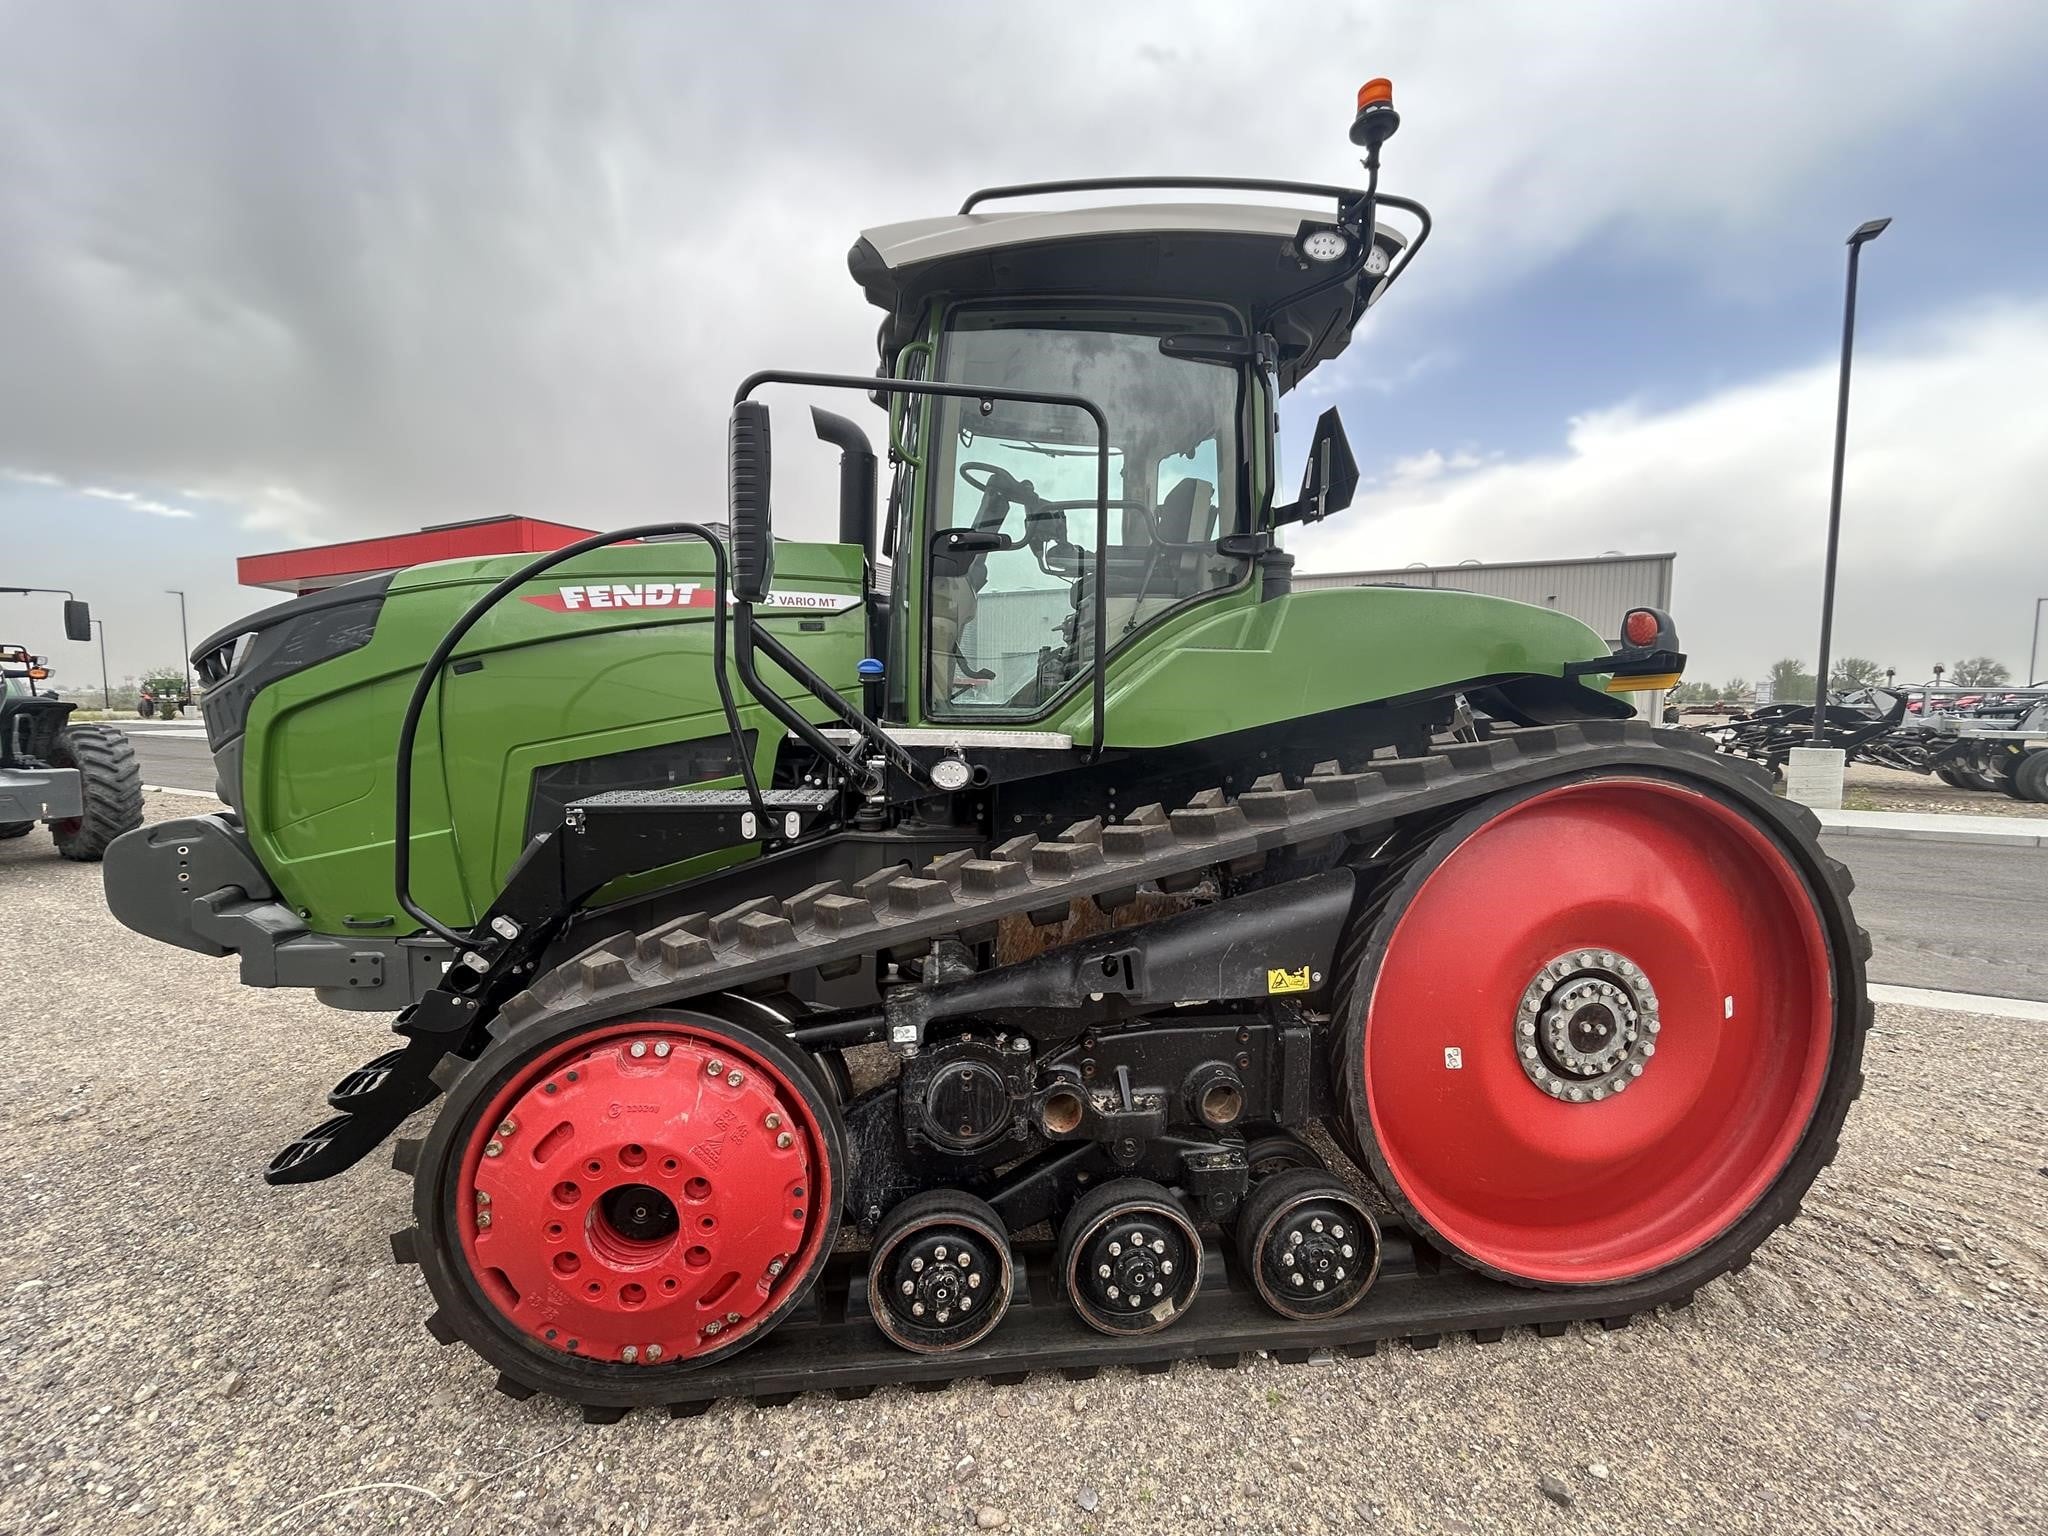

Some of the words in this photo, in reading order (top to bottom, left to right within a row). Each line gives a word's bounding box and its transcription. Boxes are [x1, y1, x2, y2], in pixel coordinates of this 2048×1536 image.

[559, 583, 701, 608] FENDT
[779, 596, 816, 606] VARIO
[819, 598, 837, 607] MT
